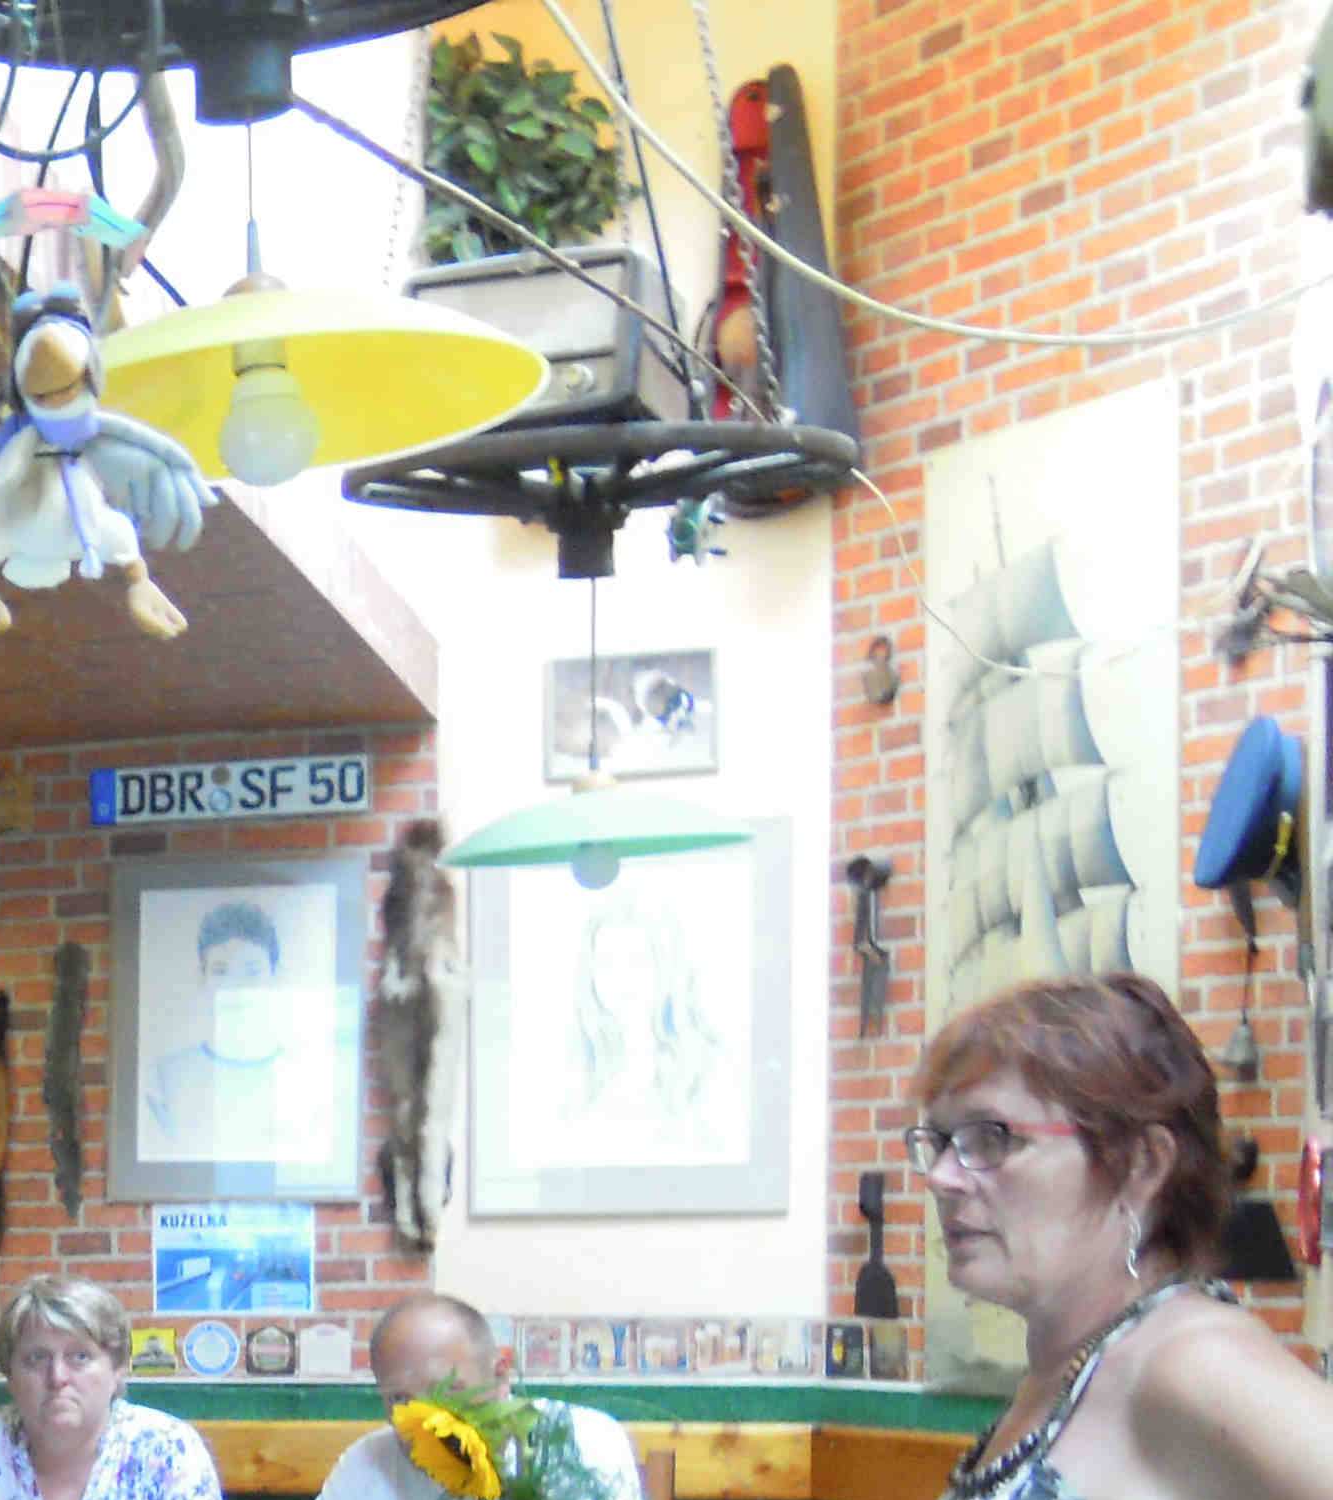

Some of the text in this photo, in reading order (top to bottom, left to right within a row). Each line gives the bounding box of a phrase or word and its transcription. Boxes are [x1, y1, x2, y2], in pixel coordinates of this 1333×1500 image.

[119, 760, 366, 816] DBR SF 50
